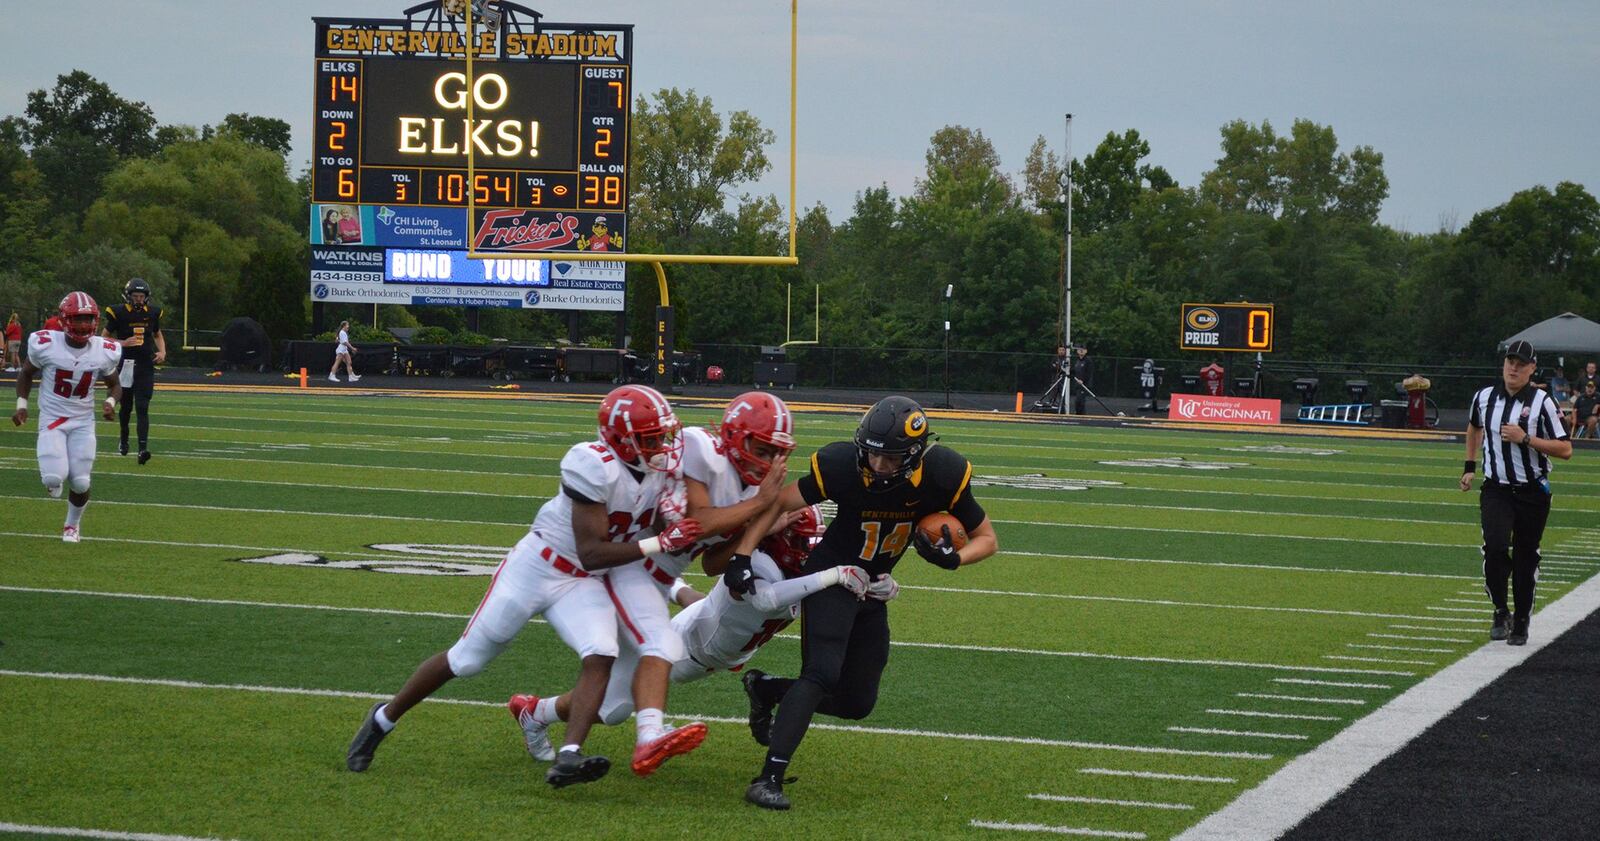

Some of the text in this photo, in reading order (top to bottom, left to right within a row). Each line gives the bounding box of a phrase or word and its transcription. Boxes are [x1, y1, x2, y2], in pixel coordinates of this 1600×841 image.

[506, 31, 618, 58] STADIUM
[322, 62, 355, 73] ELKS
[585, 68, 624, 79] GUEST
[331, 75, 357, 102] 14
[433, 71, 509, 110] GO
[607, 81, 622, 109] 7
[322, 110, 354, 119] DOWN
[592, 117, 614, 126] QTR
[329, 122, 345, 150] 2
[398, 116, 540, 158] ELKS!
[594, 128, 611, 157] 2
[321, 157, 353, 166] TO GO
[580, 164, 624, 173] BALL ON
[338, 169, 354, 197] 6
[392, 174, 411, 182] TOL
[526, 178, 546, 186] TOL
[396, 184, 406, 200] 3
[531, 187, 541, 205] 3
[584, 176, 620, 204] 38
[394, 217, 439, 229] CHI Living
[394, 226, 453, 236] Communities
[420, 238, 431, 246] St.
[313, 250, 383, 261] WATKINS
[482, 258, 541, 281] YOUR
[313, 272, 381, 282] 434-8898
[553, 279, 622, 290] Real Estate Experts
[331, 287, 410, 299] Burke Orthodontics
[415, 286, 520, 297] 630-3280 Burke-Ortho.com
[542, 294, 622, 304] Burke Orthodontics
[1248, 310, 1270, 348] 0
[1184, 331, 1219, 345] PRIDE
[52, 368, 94, 400] 54
[1141, 376, 1155, 388] 70
[608, 399, 633, 427] F
[725, 400, 753, 424] F
[859, 521, 913, 561] 14
